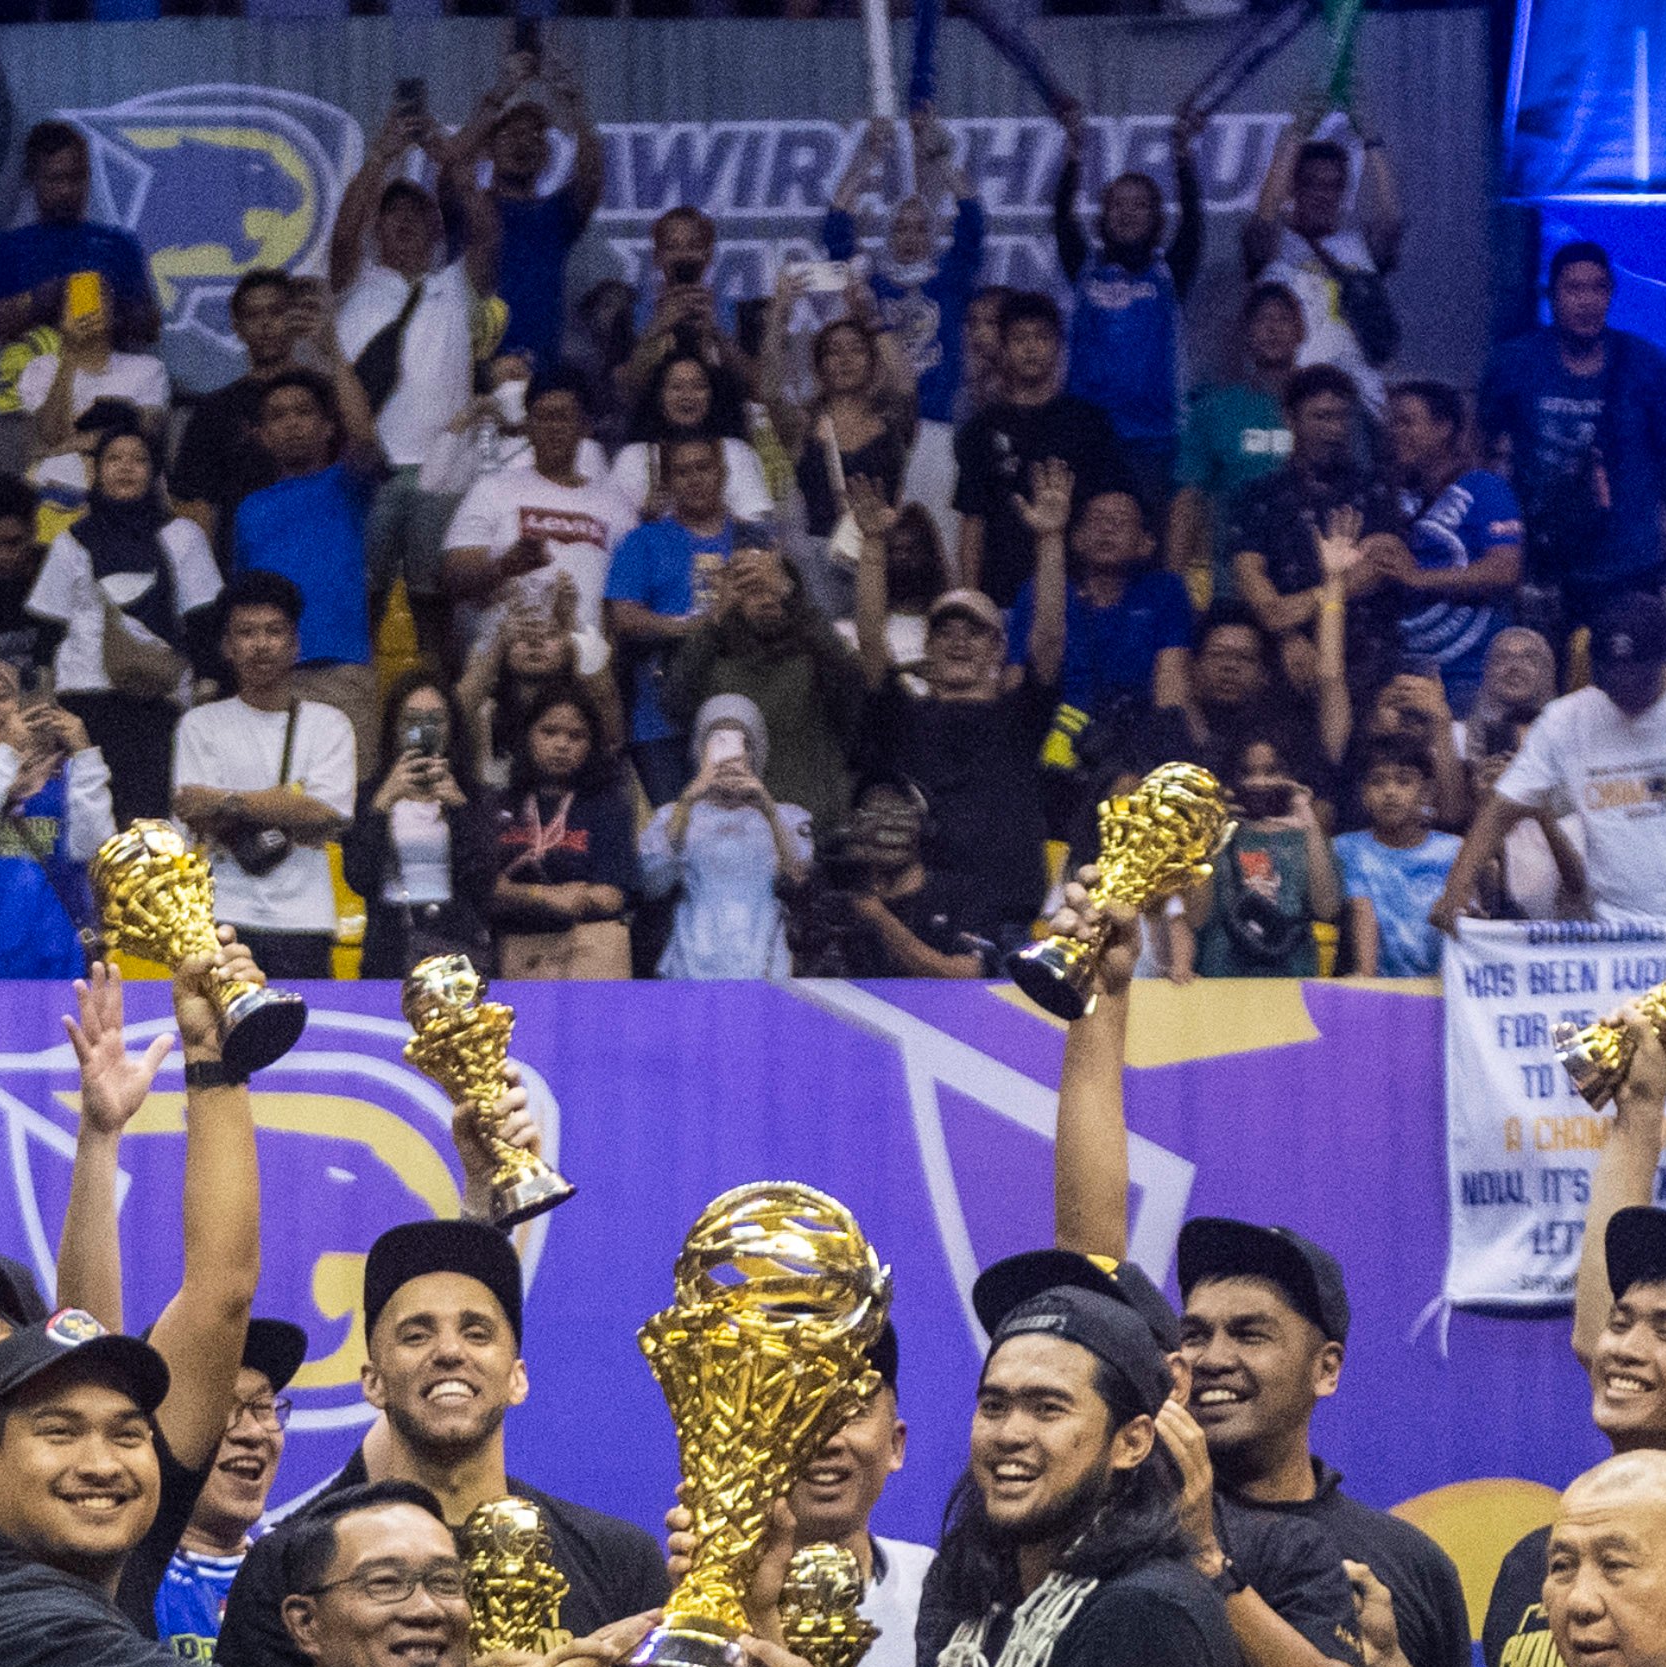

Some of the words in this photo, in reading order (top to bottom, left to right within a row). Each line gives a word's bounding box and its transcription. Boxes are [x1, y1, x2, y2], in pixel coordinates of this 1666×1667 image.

[1528, 959, 1601, 995] BEEN
[1496, 1011, 1549, 1049] FOR
[1520, 1062, 1554, 1098] TO
